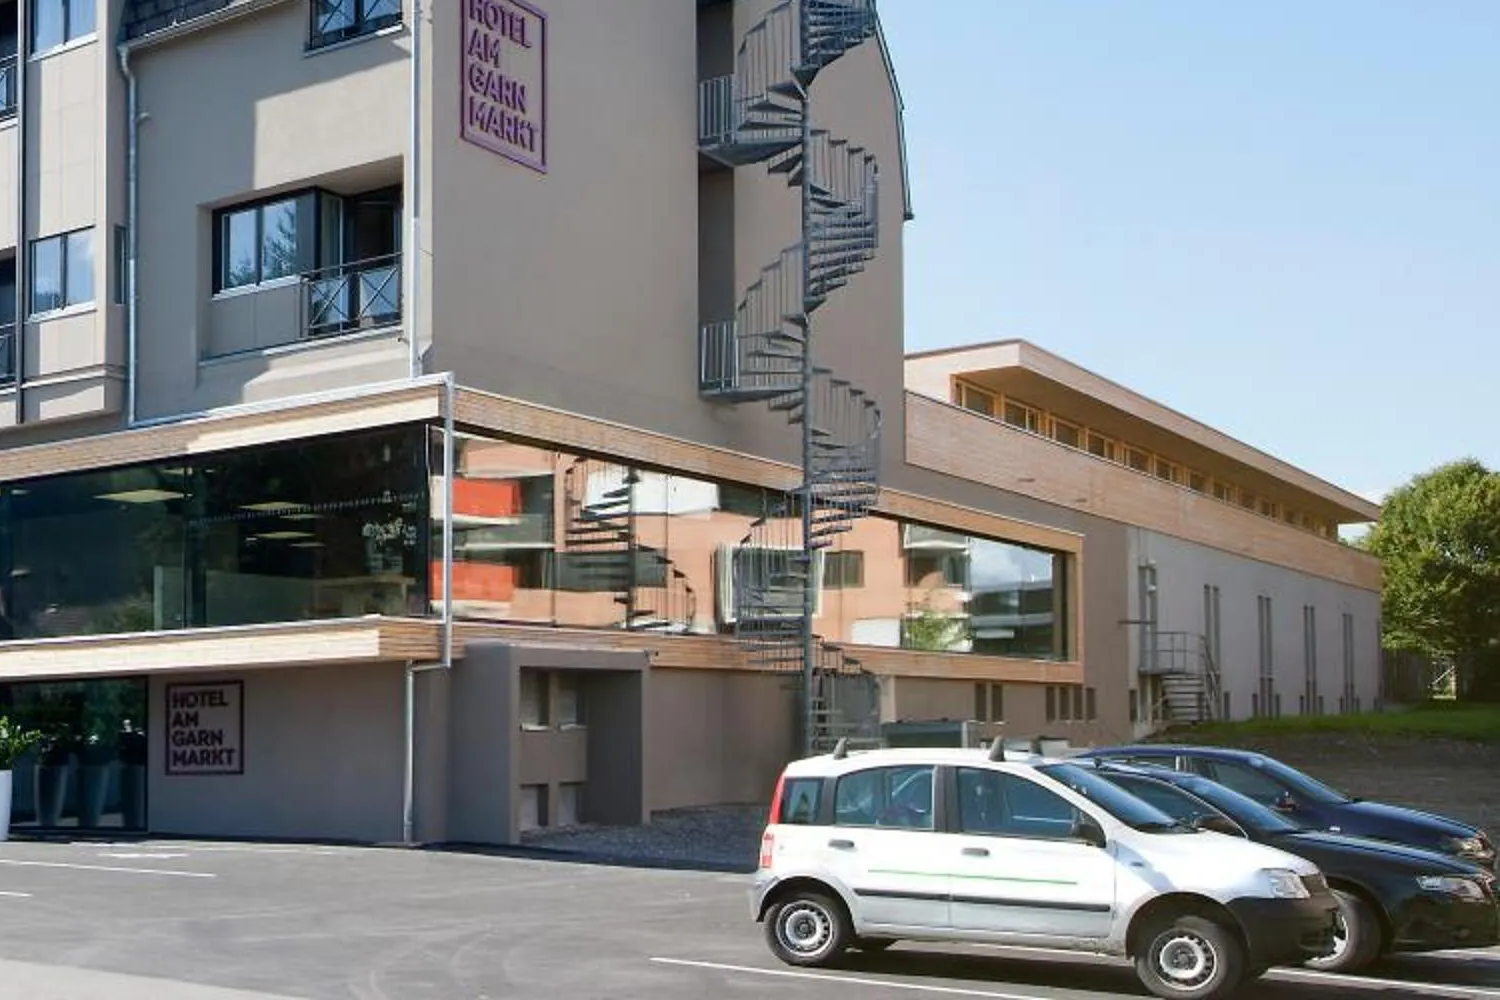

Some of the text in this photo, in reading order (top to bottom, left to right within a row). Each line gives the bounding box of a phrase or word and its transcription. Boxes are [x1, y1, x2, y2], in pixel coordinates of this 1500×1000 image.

[467, 28, 500, 68] AM
[468, 62, 527, 114] GARN
[469, 95, 536, 152] MARKT
[172, 690, 229, 709] HOTEL
[172, 711, 199, 728] AM
[172, 729, 223, 747] GARN
[172, 748, 236, 767] MARKT
